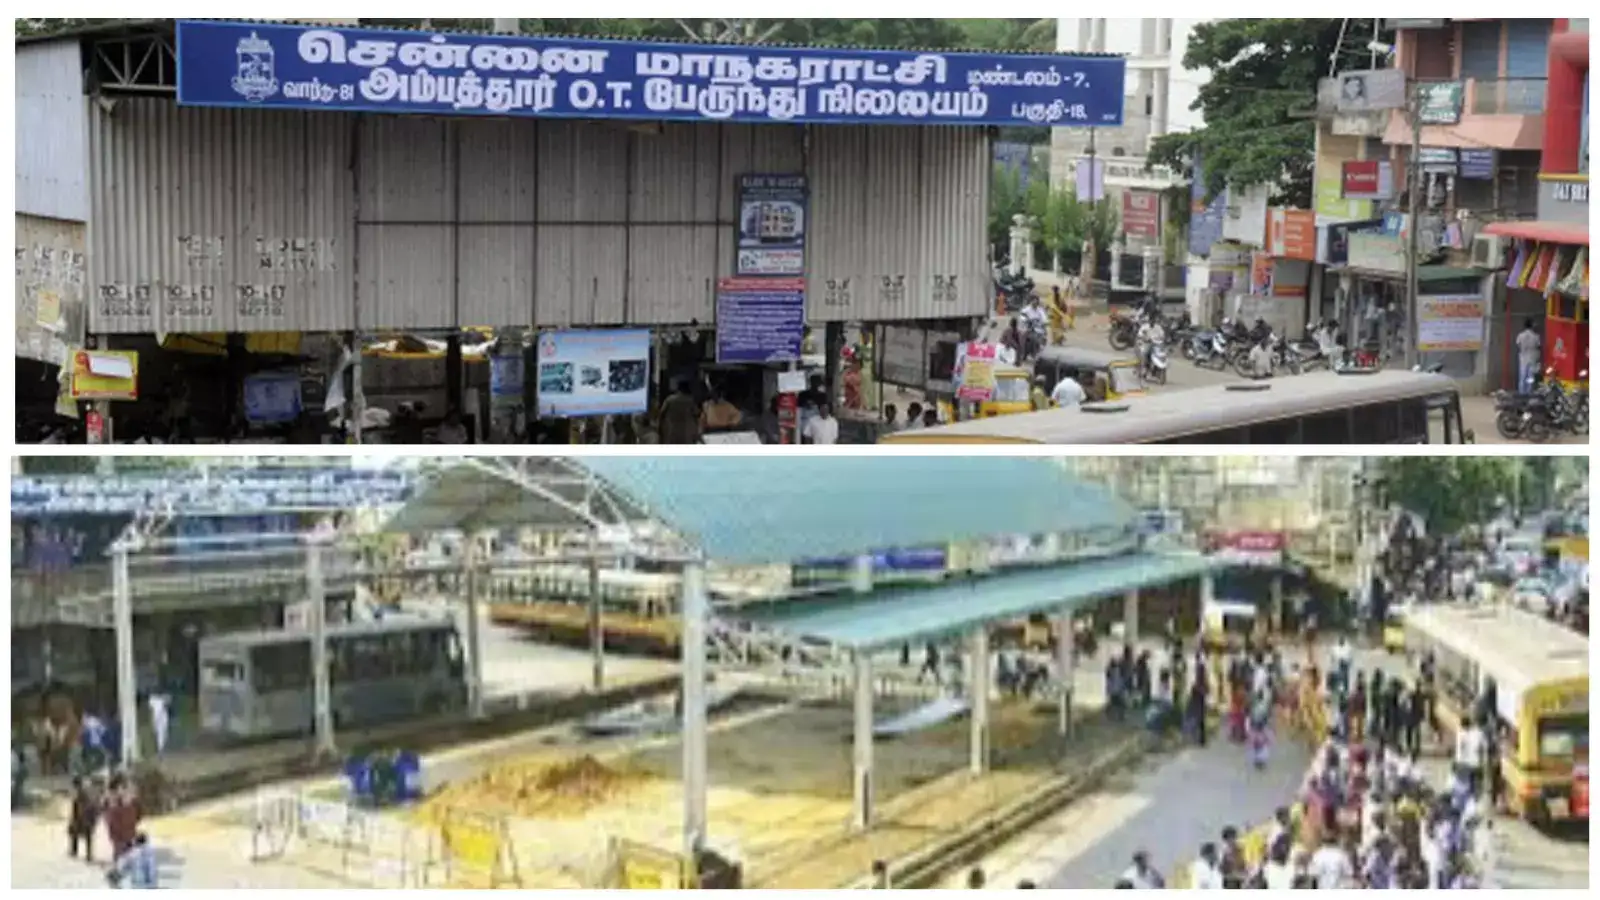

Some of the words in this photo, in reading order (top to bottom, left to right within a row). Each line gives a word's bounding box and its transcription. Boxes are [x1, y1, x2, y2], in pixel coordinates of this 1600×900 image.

[297, 29, 609, 76] சென்னை
[635, 52, 947, 87] மாநகராட்சி
[359, 67, 558, 113] அம்பத்தூர்
[569, 79, 632, 109] O.T.
[644, 78, 806, 119] பேருந்து
[818, 82, 989, 117] நிலையம்
